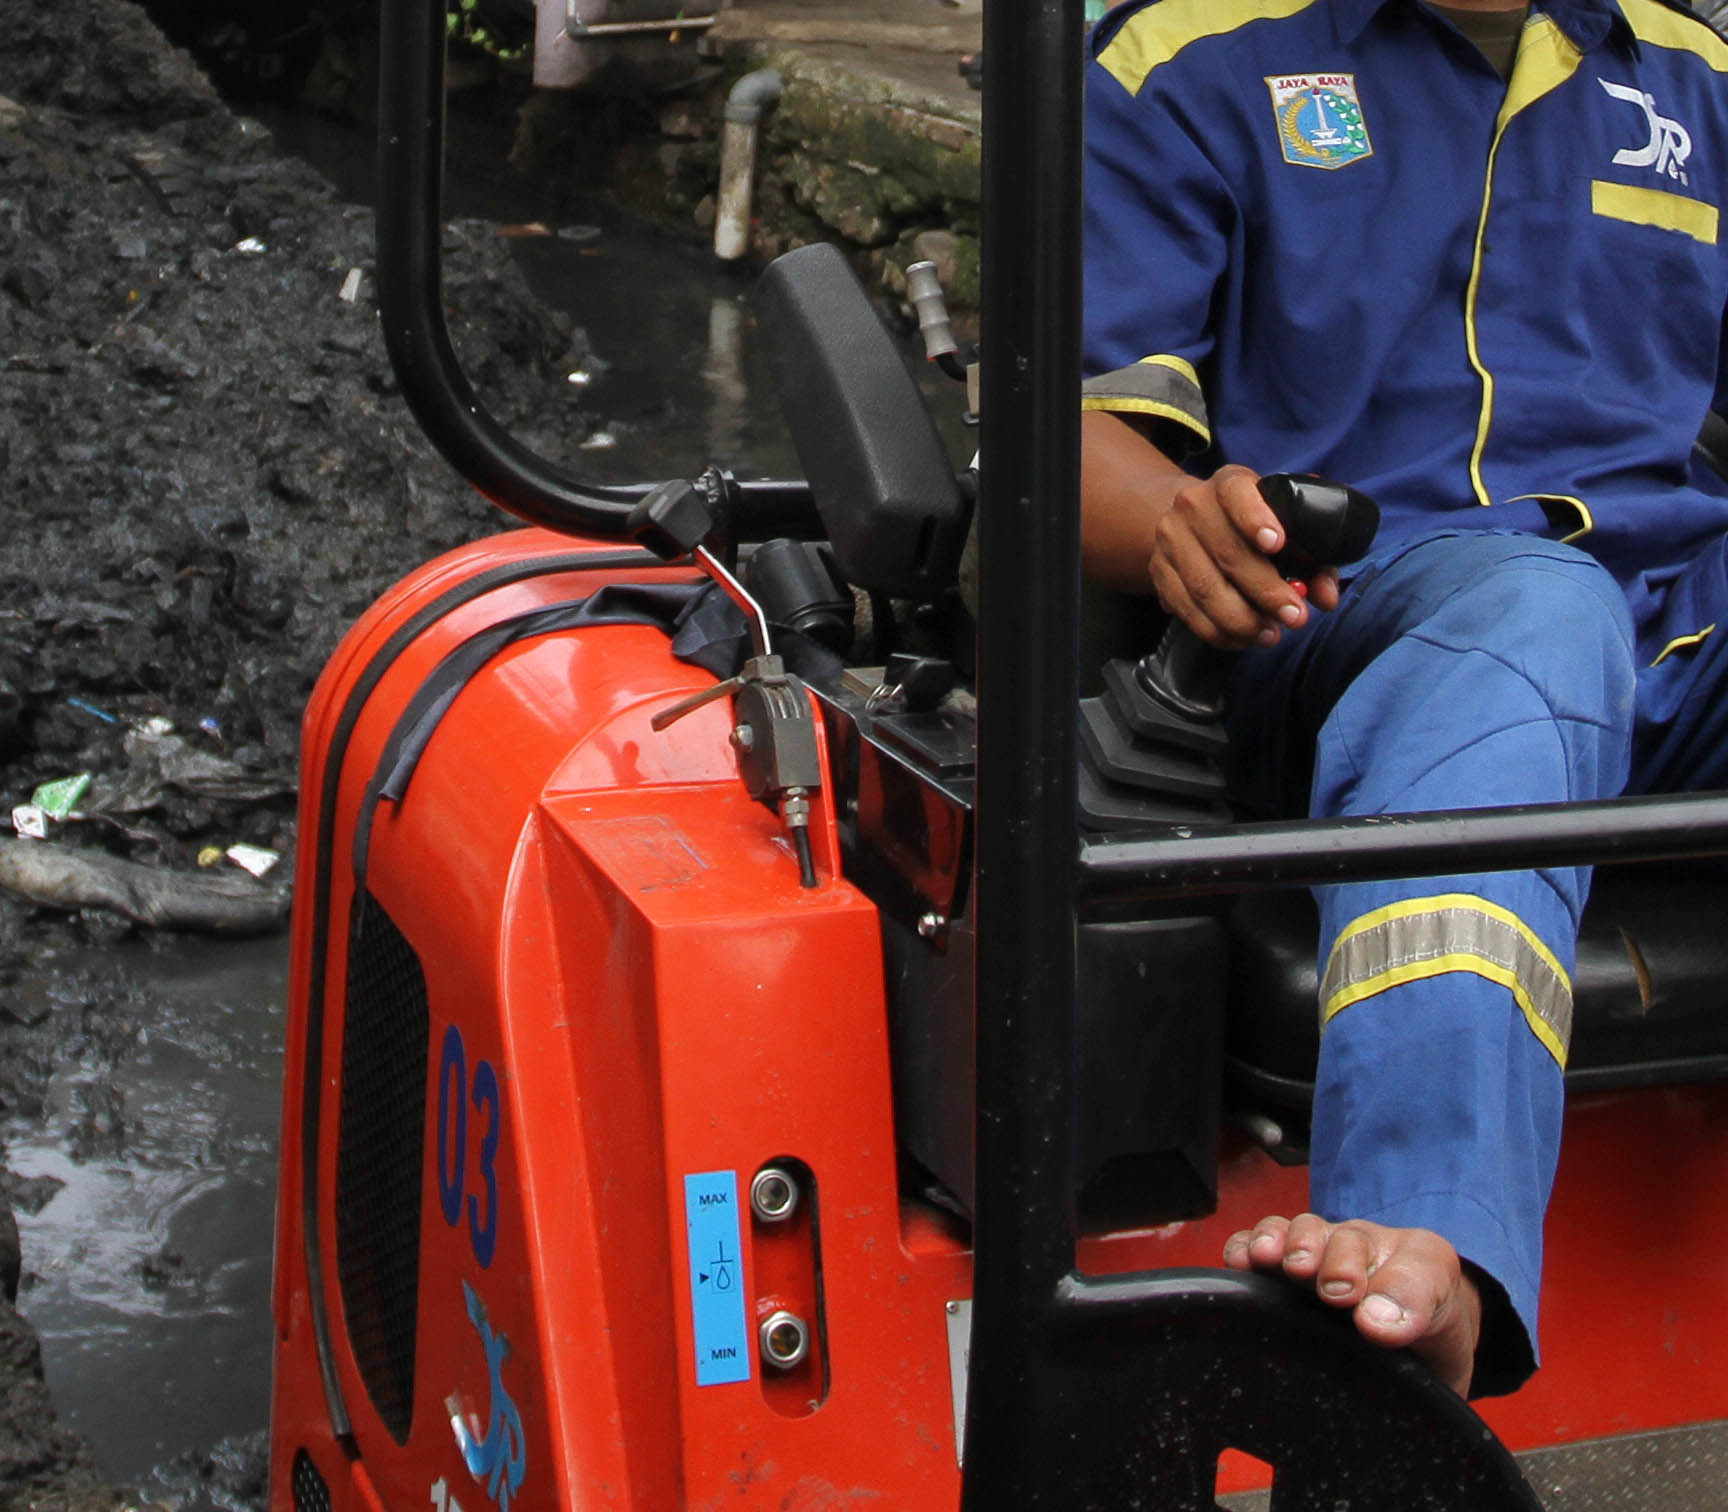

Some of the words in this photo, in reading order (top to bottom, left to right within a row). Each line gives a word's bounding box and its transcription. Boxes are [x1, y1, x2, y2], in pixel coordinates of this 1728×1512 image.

[1277, 78, 1309, 89] JAYA
[1318, 76, 1349, 87] RAYA
[438, 1024, 500, 1269] 03
[699, 1192, 728, 1206] MAX
[710, 1347, 737, 1361] MIN
